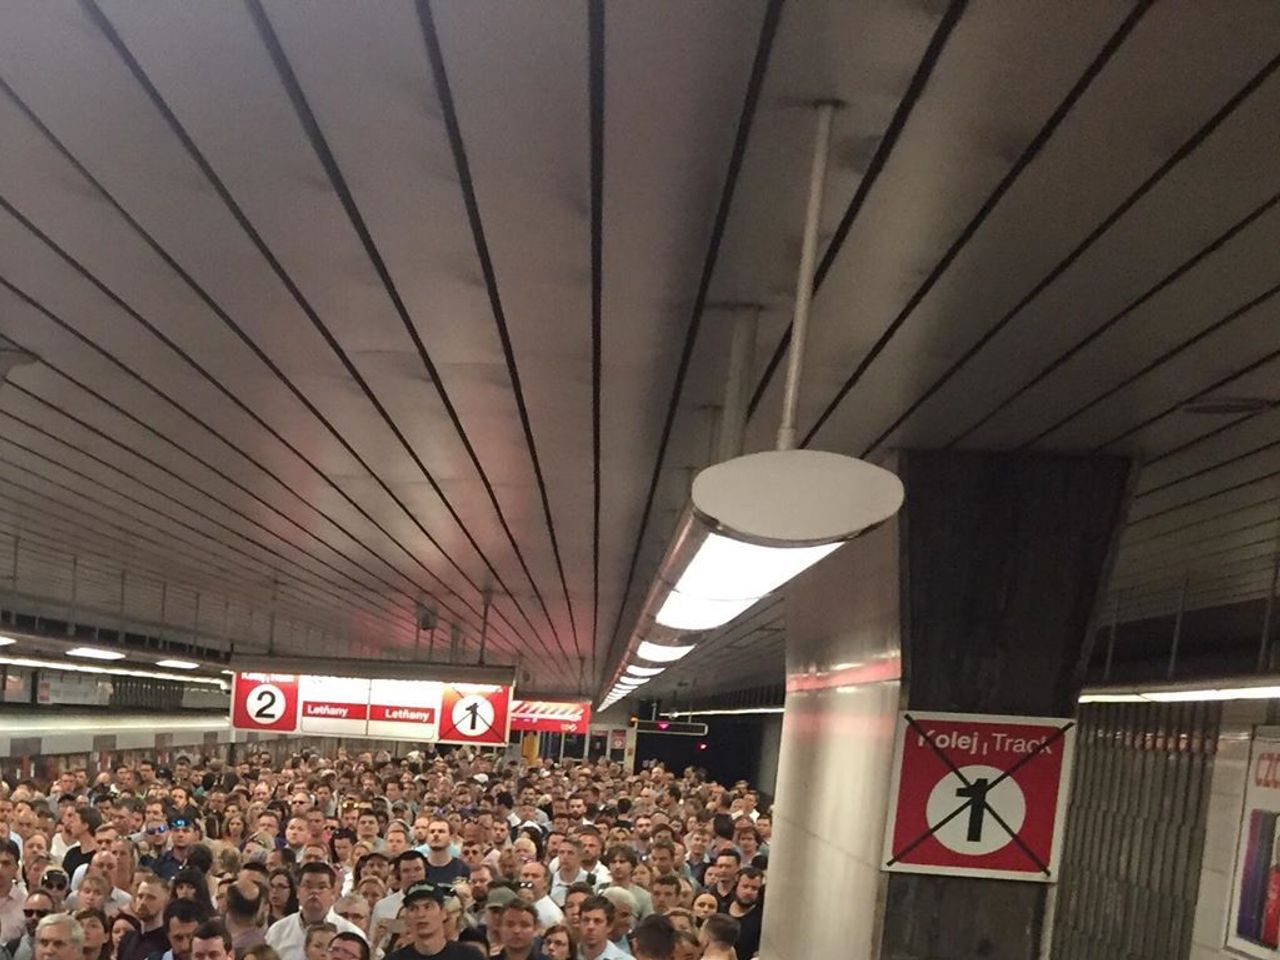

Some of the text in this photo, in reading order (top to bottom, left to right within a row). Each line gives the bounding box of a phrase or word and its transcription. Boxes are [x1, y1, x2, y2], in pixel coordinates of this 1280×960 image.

[254, 690, 276, 719] 2
[465, 702, 479, 730] 1
[955, 777, 988, 842] 1
